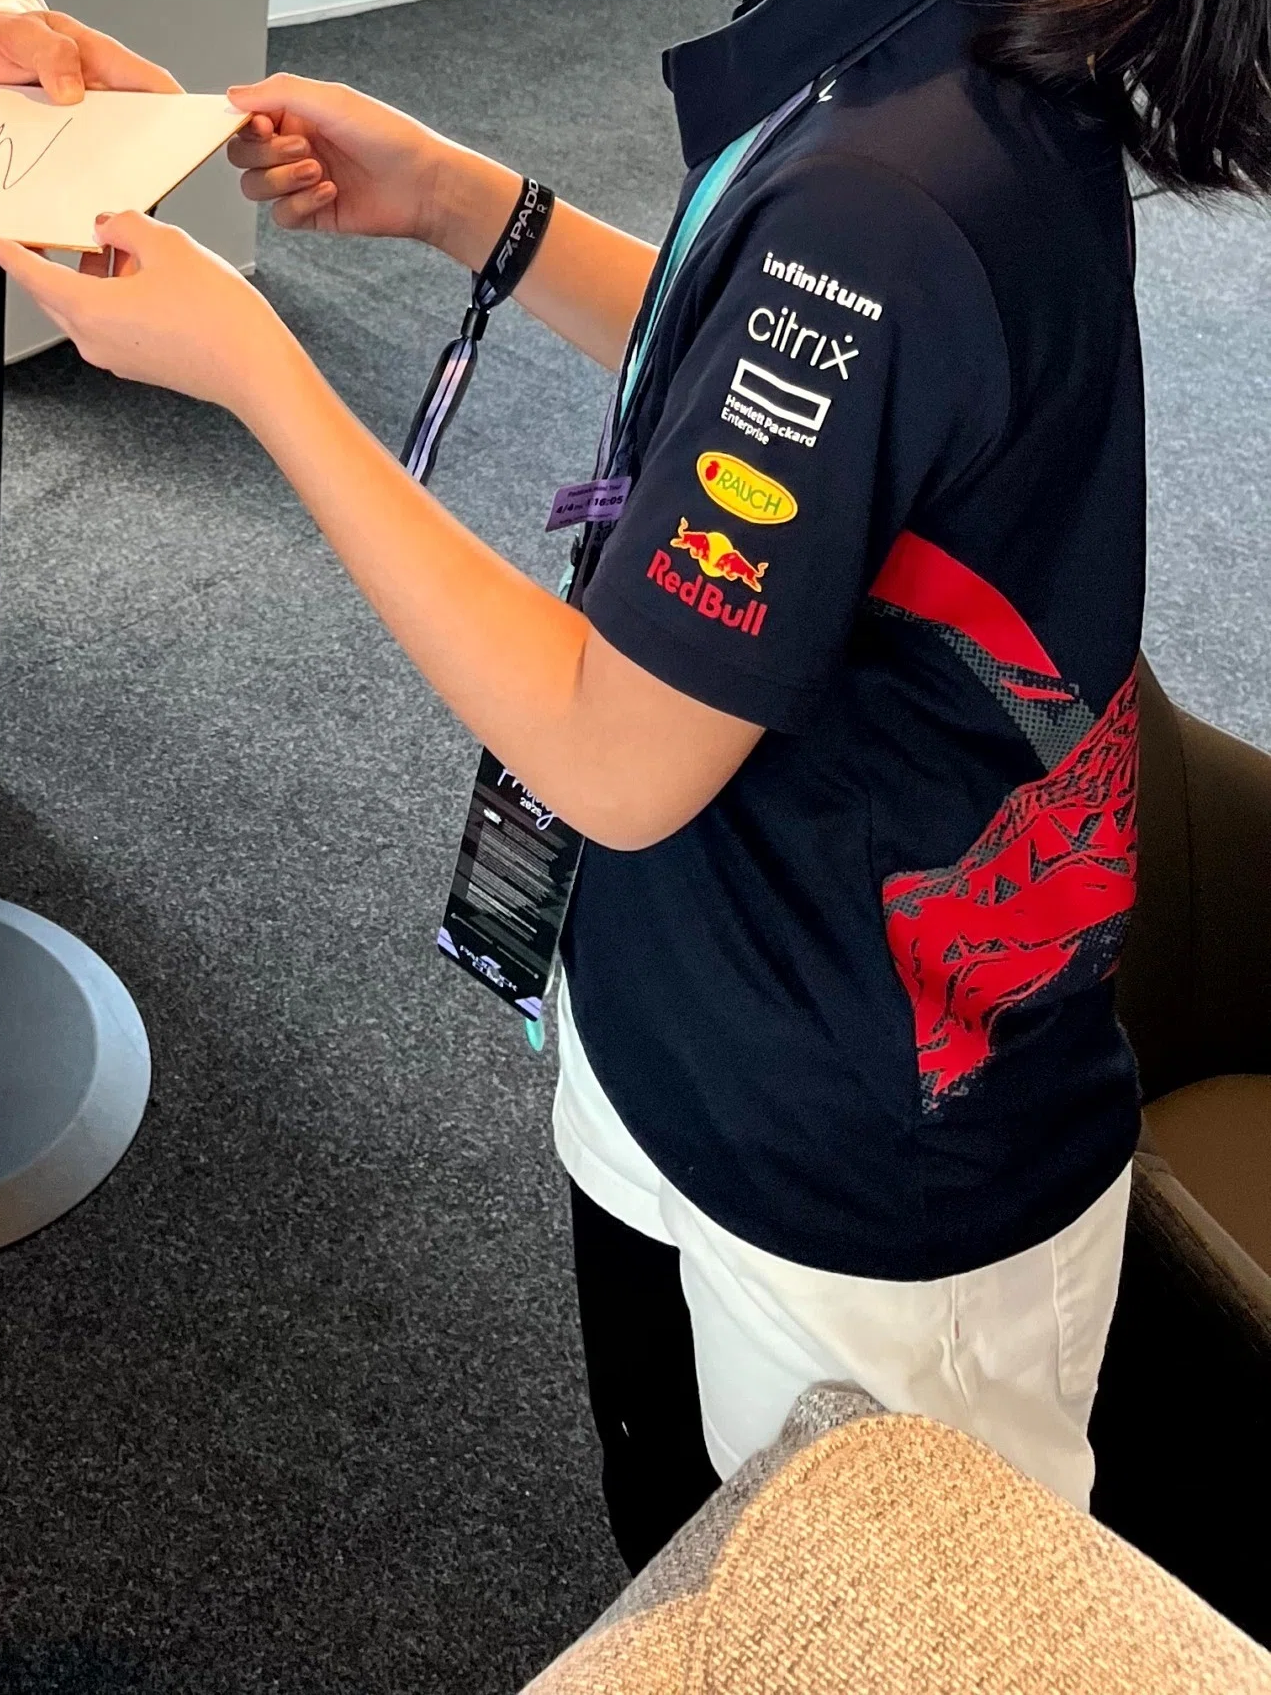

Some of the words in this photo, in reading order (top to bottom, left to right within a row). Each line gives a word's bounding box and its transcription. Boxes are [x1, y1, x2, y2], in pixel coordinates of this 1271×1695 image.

[762, 252, 883, 321] infinitum
[747, 307, 859, 381] citrix
[721, 406, 769, 445] Enterprise
[725, 394, 765, 425] Hewlett
[764, 417, 817, 447] Packard
[594, 496, 624, 506] 16:05
[715, 468, 782, 516] RAUCH
[698, 590, 769, 637] Bull
